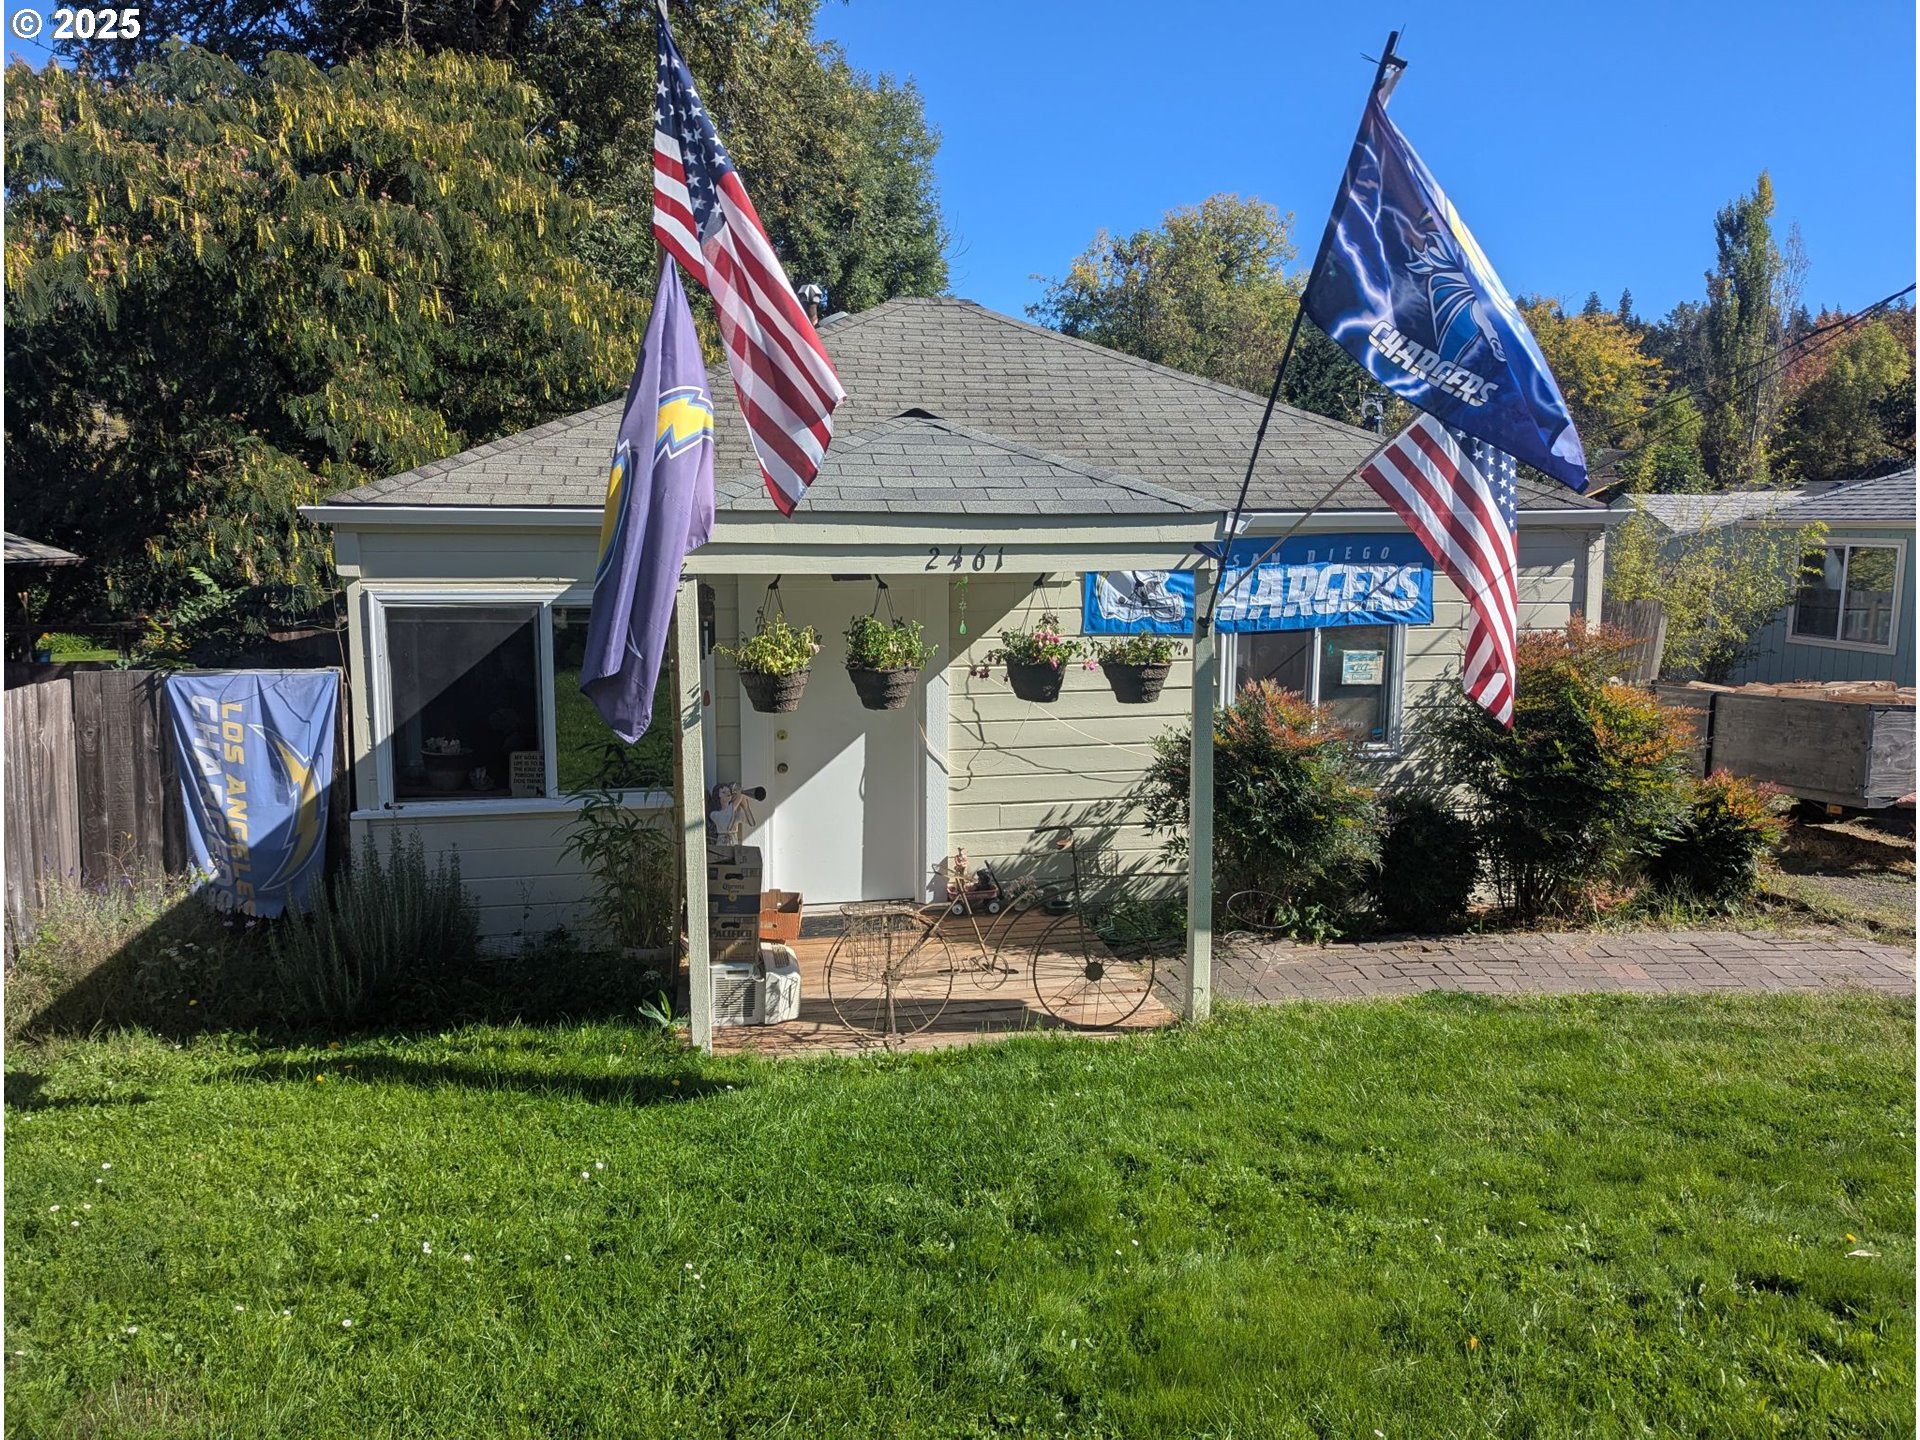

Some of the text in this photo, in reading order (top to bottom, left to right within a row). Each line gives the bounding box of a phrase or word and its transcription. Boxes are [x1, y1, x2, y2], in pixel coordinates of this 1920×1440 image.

[1368, 320, 1499, 407] CHARGERS
[924, 545, 1004, 573] 2461
[1232, 546, 1391, 567] SAN DIEGO
[1218, 561, 1423, 621] HARGERS
[219, 700, 257, 917] LOS ANGELES
